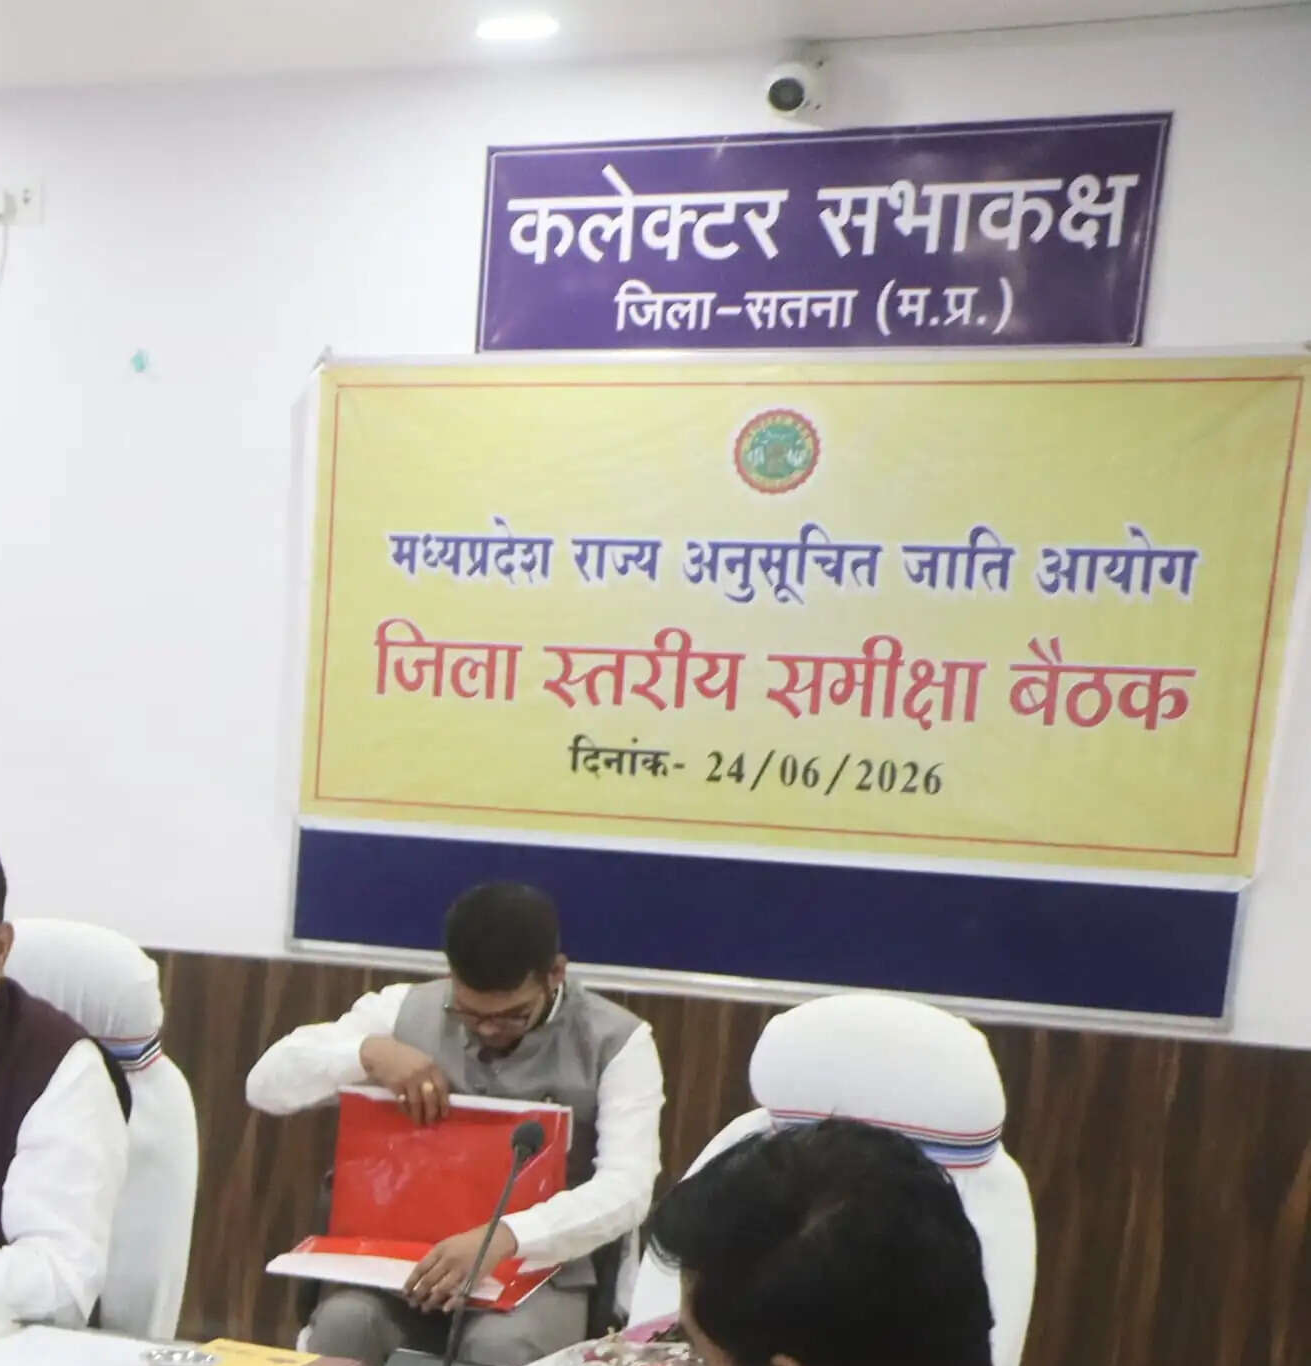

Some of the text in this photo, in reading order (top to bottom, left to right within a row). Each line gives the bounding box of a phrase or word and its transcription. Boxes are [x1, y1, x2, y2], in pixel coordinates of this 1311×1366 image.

[507, 164, 1140, 264] कलेक्टर सभाकक्ष
[614, 279, 858, 331] जिला-सतना
[390, 515, 1198, 604] मध्यप्रदेश राज्य अनुसूचित जाति आयोग
[374, 618, 1196, 730] जिला स्तरीय समीक्षा बैठक
[705, 749, 947, 796] 24/06/2026
